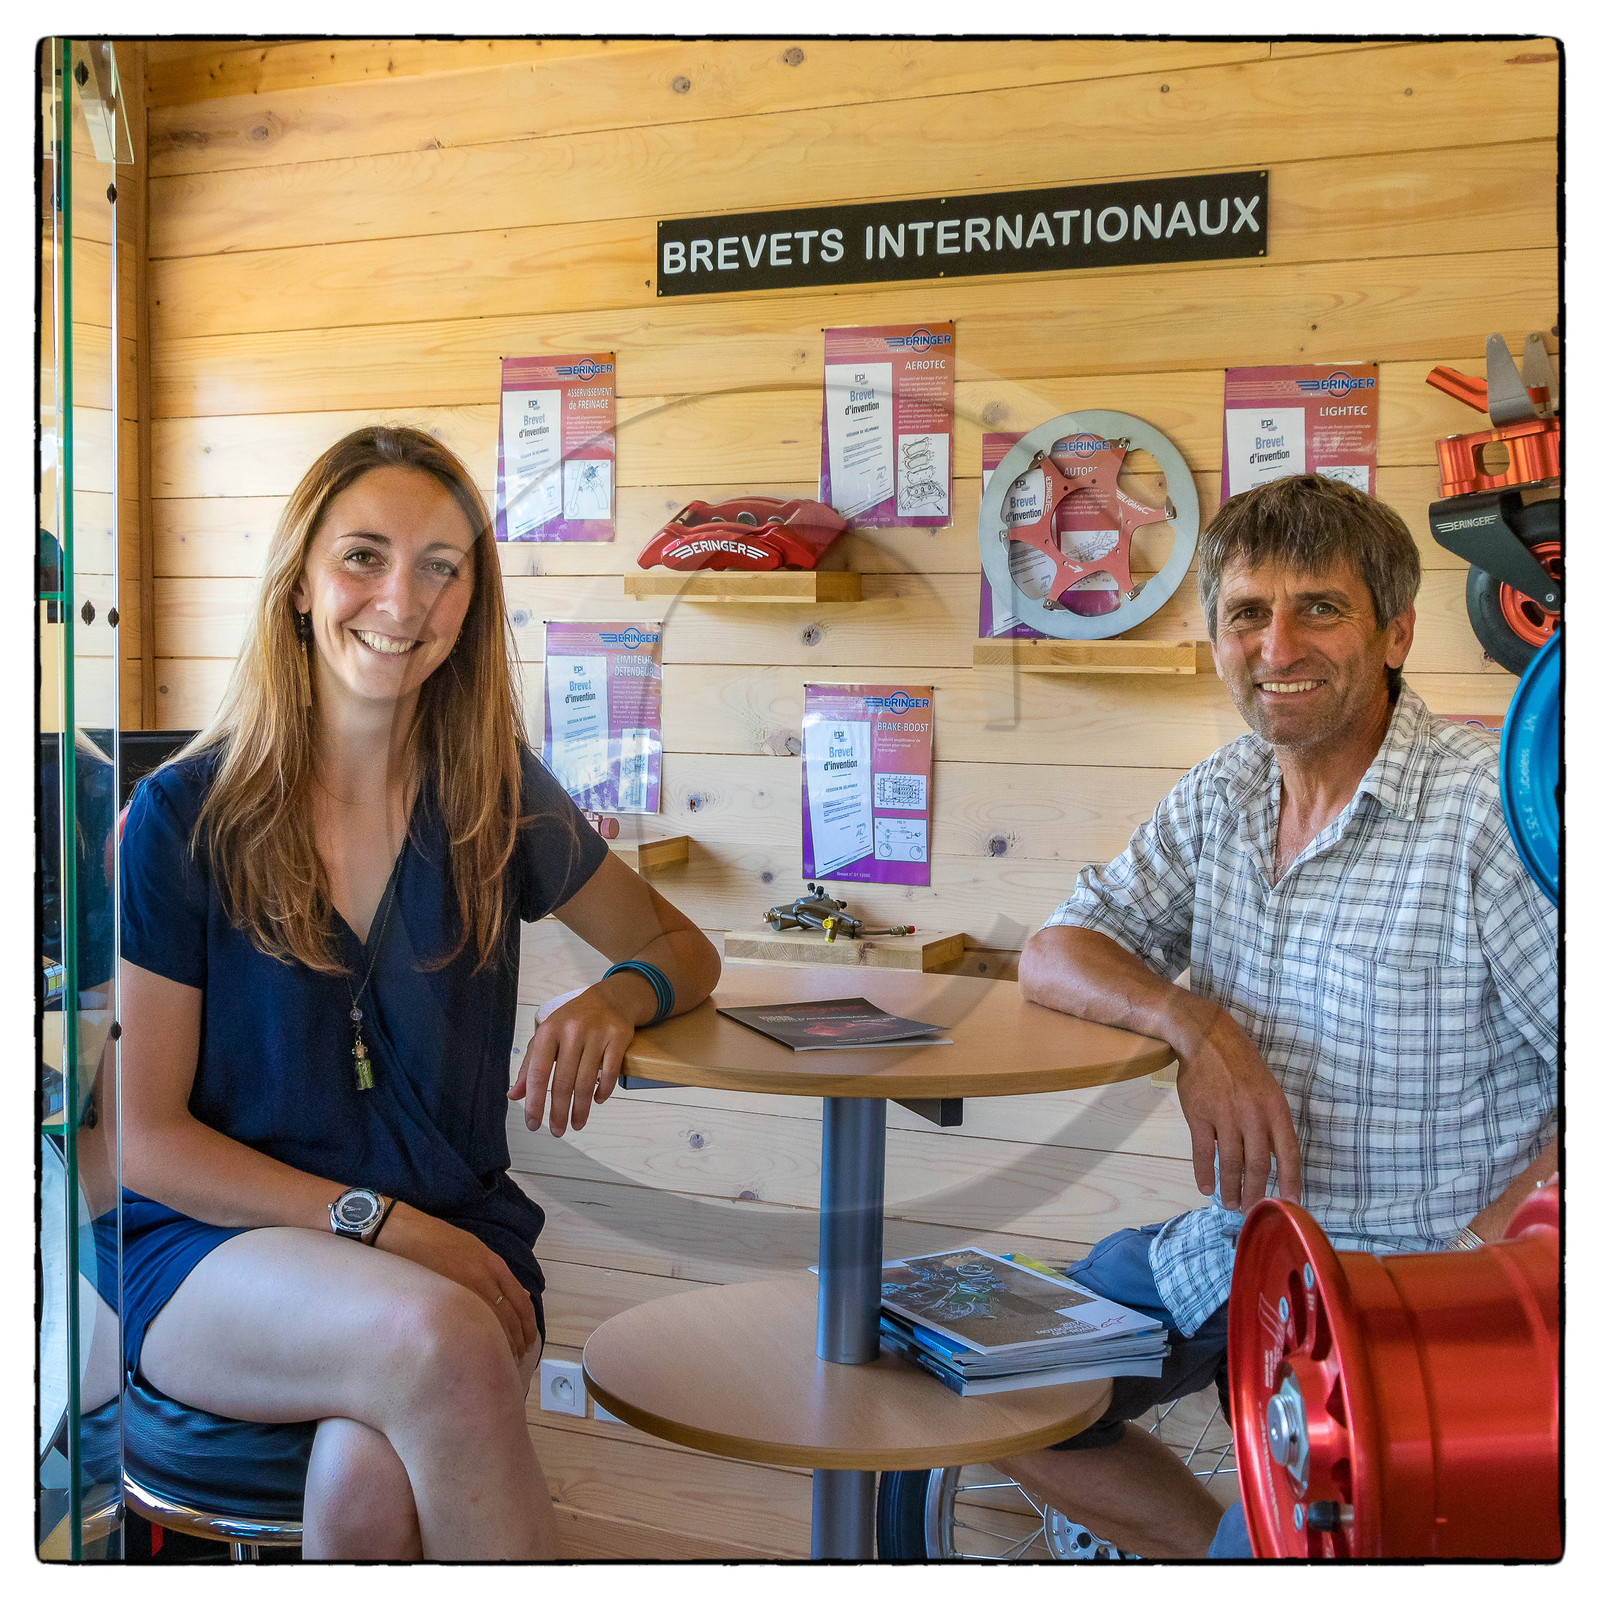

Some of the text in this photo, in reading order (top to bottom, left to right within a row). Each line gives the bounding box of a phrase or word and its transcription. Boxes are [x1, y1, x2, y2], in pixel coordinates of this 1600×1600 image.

[663, 194, 1262, 276] BREVETS INTERNATIONAUX
[884, 334, 952, 347] BERINGER
[554, 363, 614, 376] BERINGER
[905, 359, 946, 370] AEROTEC
[1296, 377, 1375, 391] BERINGER
[567, 387, 613, 398] ASSERVISSEMENT
[850, 388, 875, 402] Brevet
[568, 399, 609, 410] de FREINAGE
[844, 402, 880, 415] d'invention
[1319, 405, 1368, 417] LIGHTEC
[523, 413, 546, 426] Brevet
[518, 426, 550, 438] d'invention
[1255, 435, 1285, 450] Brevet
[1249, 450, 1290, 464] d'invention
[1044, 475, 1053, 514] BERINGER
[1010, 495, 1037, 508] Brevet
[1005, 508, 1042, 522] d'invention
[1436, 515, 1496, 533] BERINGER
[669, 540, 750, 560] BERINGER
[599, 633, 659, 643] BERINGER
[616, 654, 653, 665] LIMITEUR
[569, 680, 592, 692] Brevet
[565, 692, 596, 704] d'invention
[863, 697, 930, 708] BERINGER
[877, 721, 929, 732] BRAKE-BOOST
[829, 745, 853, 758] Brevet
[824, 760, 858, 771] d'invention
